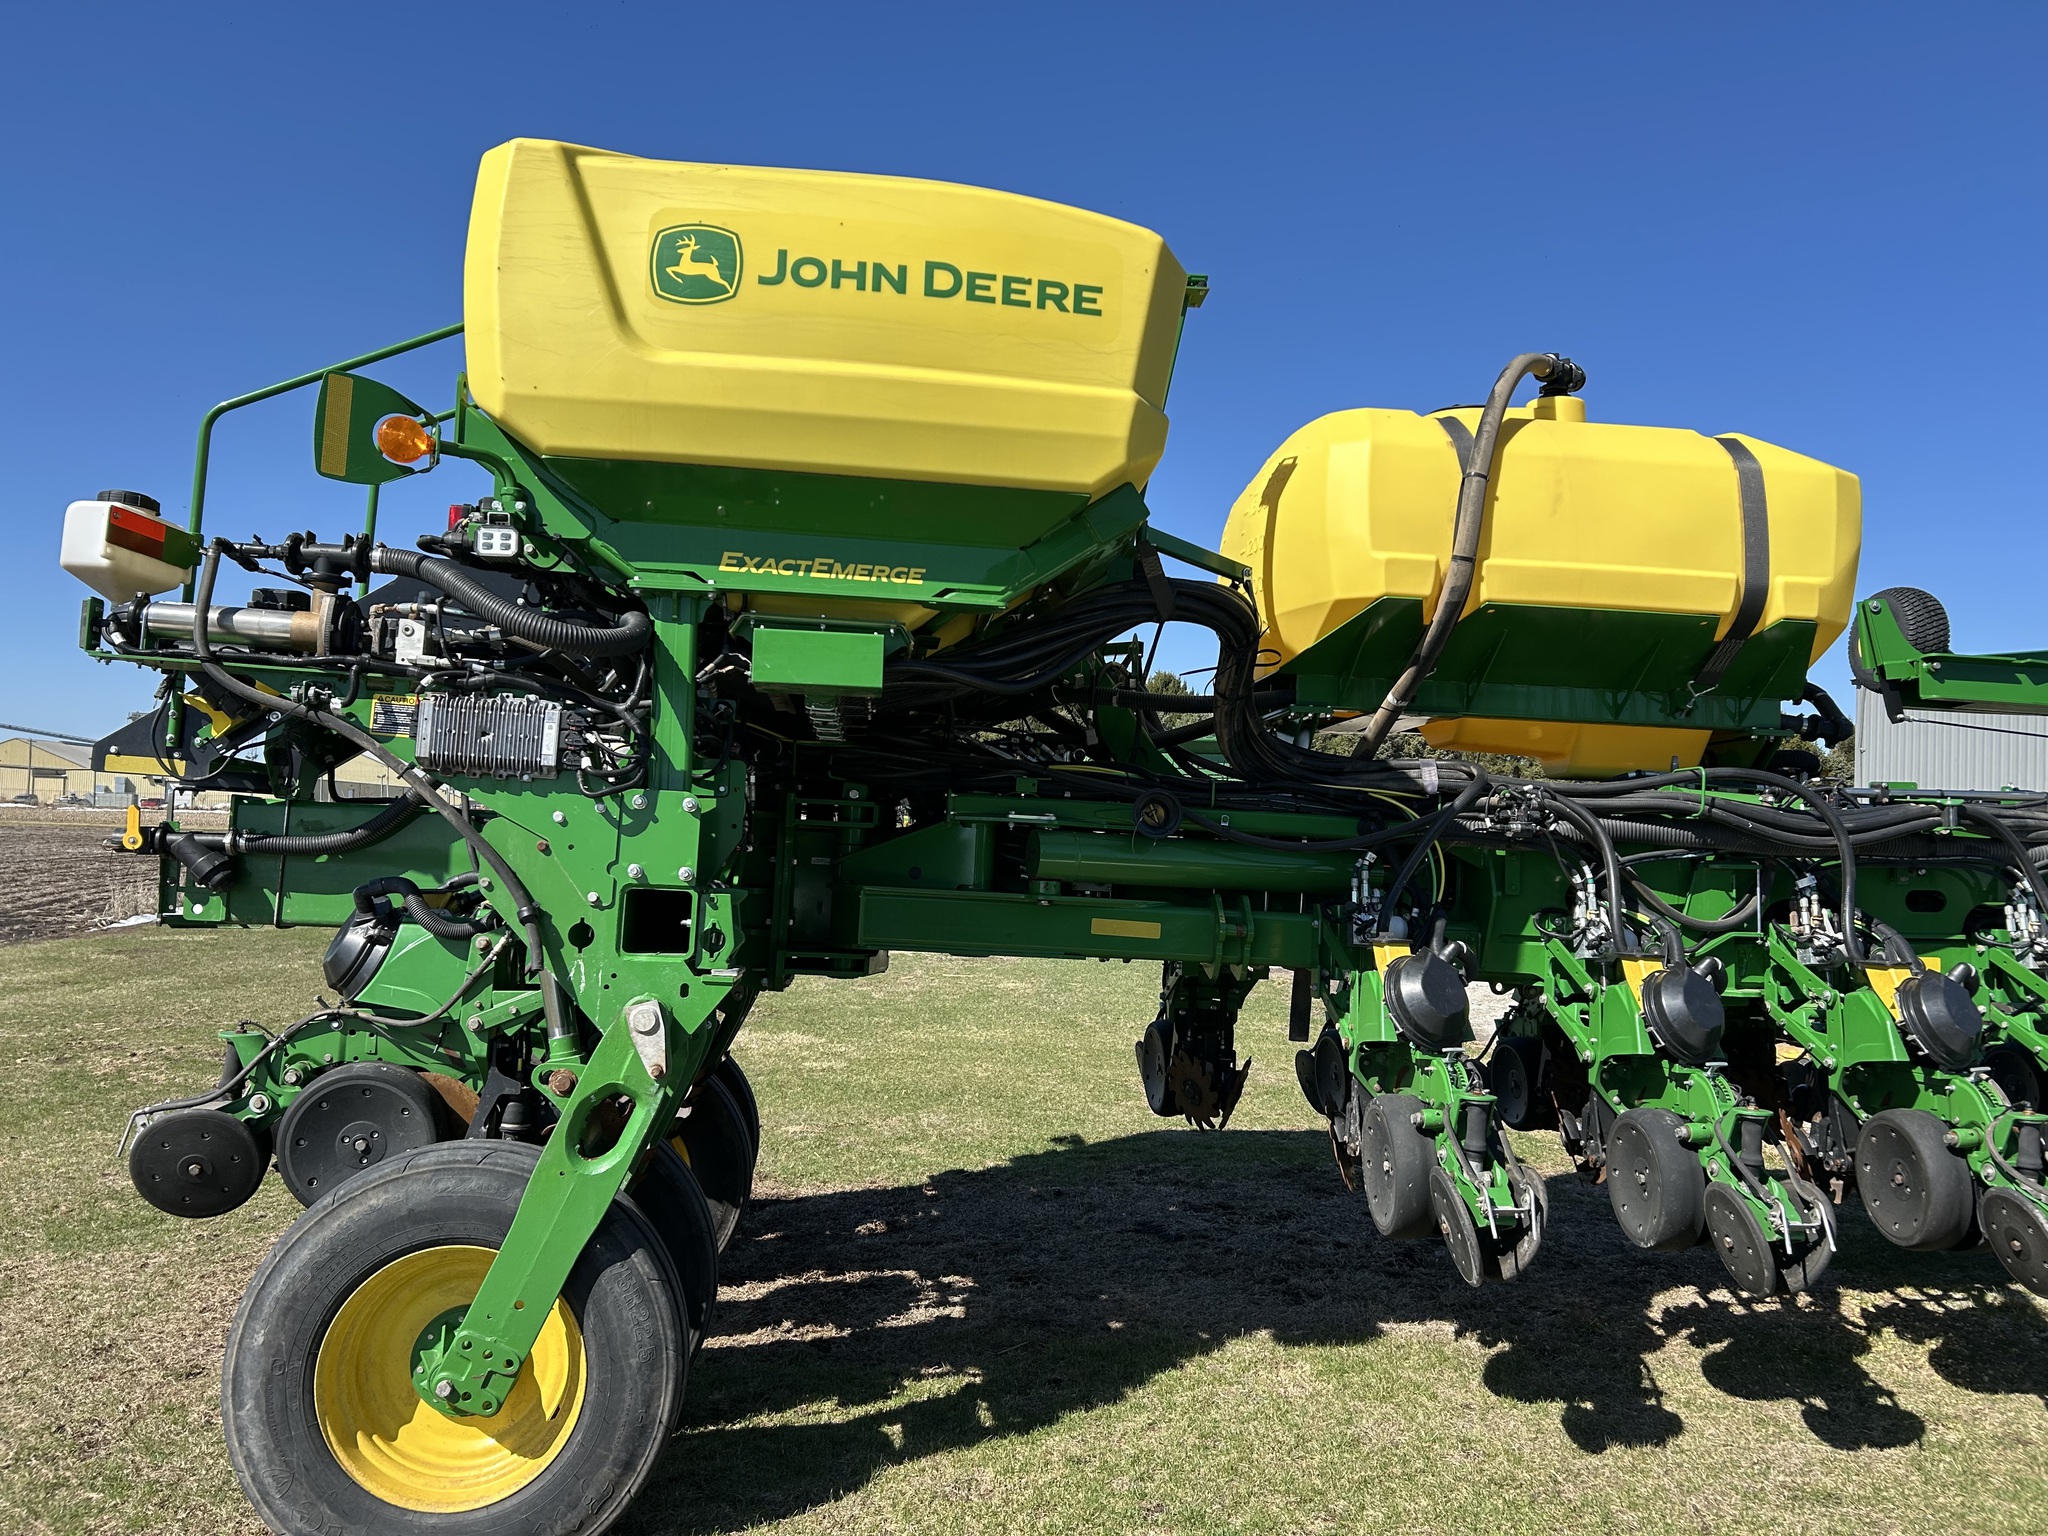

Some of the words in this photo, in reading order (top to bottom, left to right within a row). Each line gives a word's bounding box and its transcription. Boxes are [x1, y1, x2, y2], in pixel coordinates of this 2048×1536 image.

[758, 248, 908, 295] JOHN
[923, 260, 1104, 317] DEERE
[385, 695, 415, 704] CAUTIO
